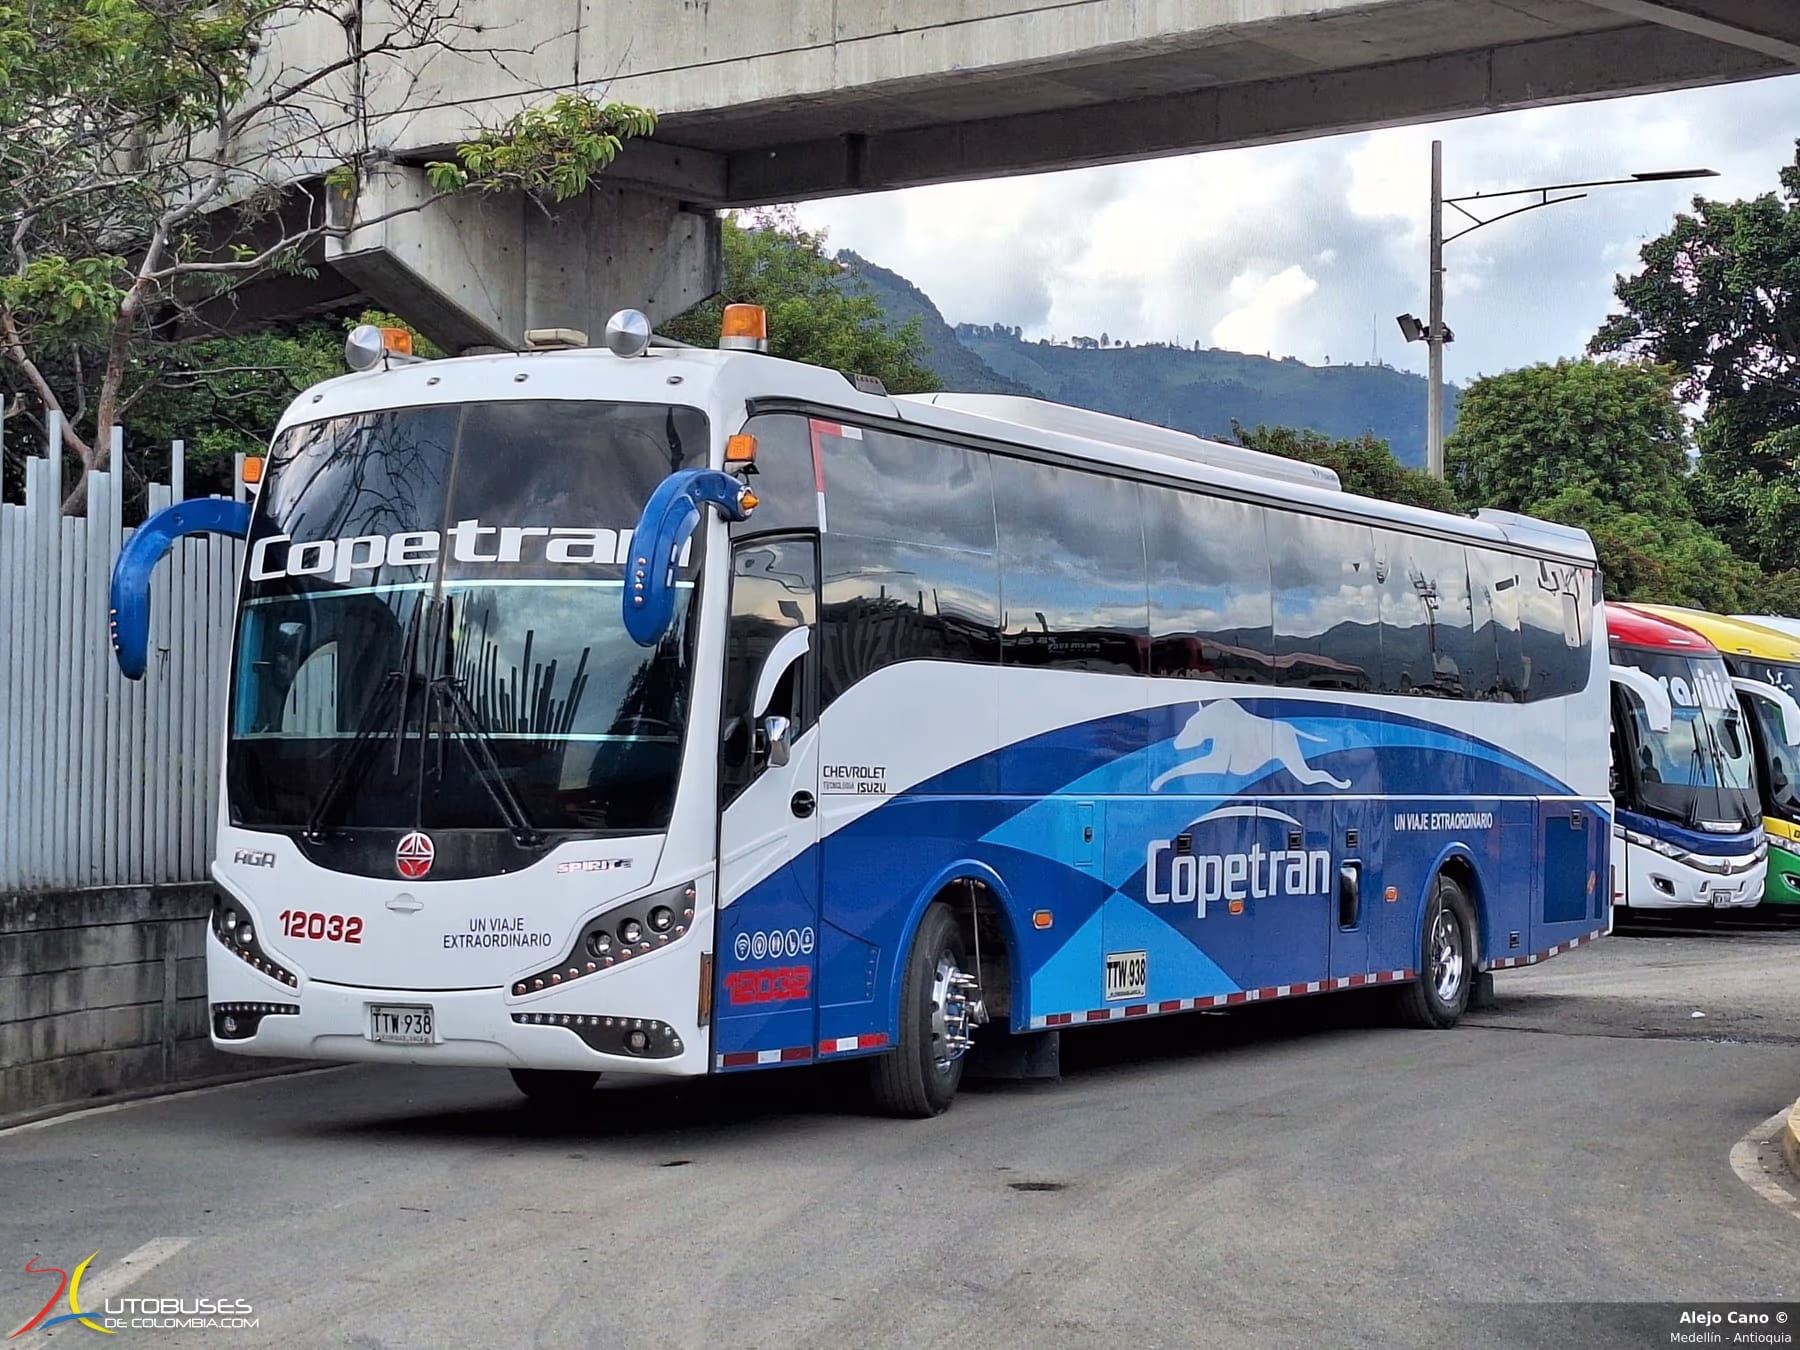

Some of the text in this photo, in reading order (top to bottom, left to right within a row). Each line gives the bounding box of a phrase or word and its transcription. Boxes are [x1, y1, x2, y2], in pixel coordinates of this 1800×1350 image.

[823, 765, 886, 779] CHEVROLET
[857, 782, 887, 793] ISUZU
[1394, 812, 1493, 831] UN VIAJE EXTRAORDINARIO
[1146, 839, 1330, 919] Copetran
[279, 910, 364, 944] 12032
[469, 917, 524, 932] UN VIAJE
[443, 933, 552, 949] EXTRAORDINARIO
[1129, 958, 1146, 987] 938
[724, 966, 811, 1005] 12032
[404, 1014, 432, 1035] 938
